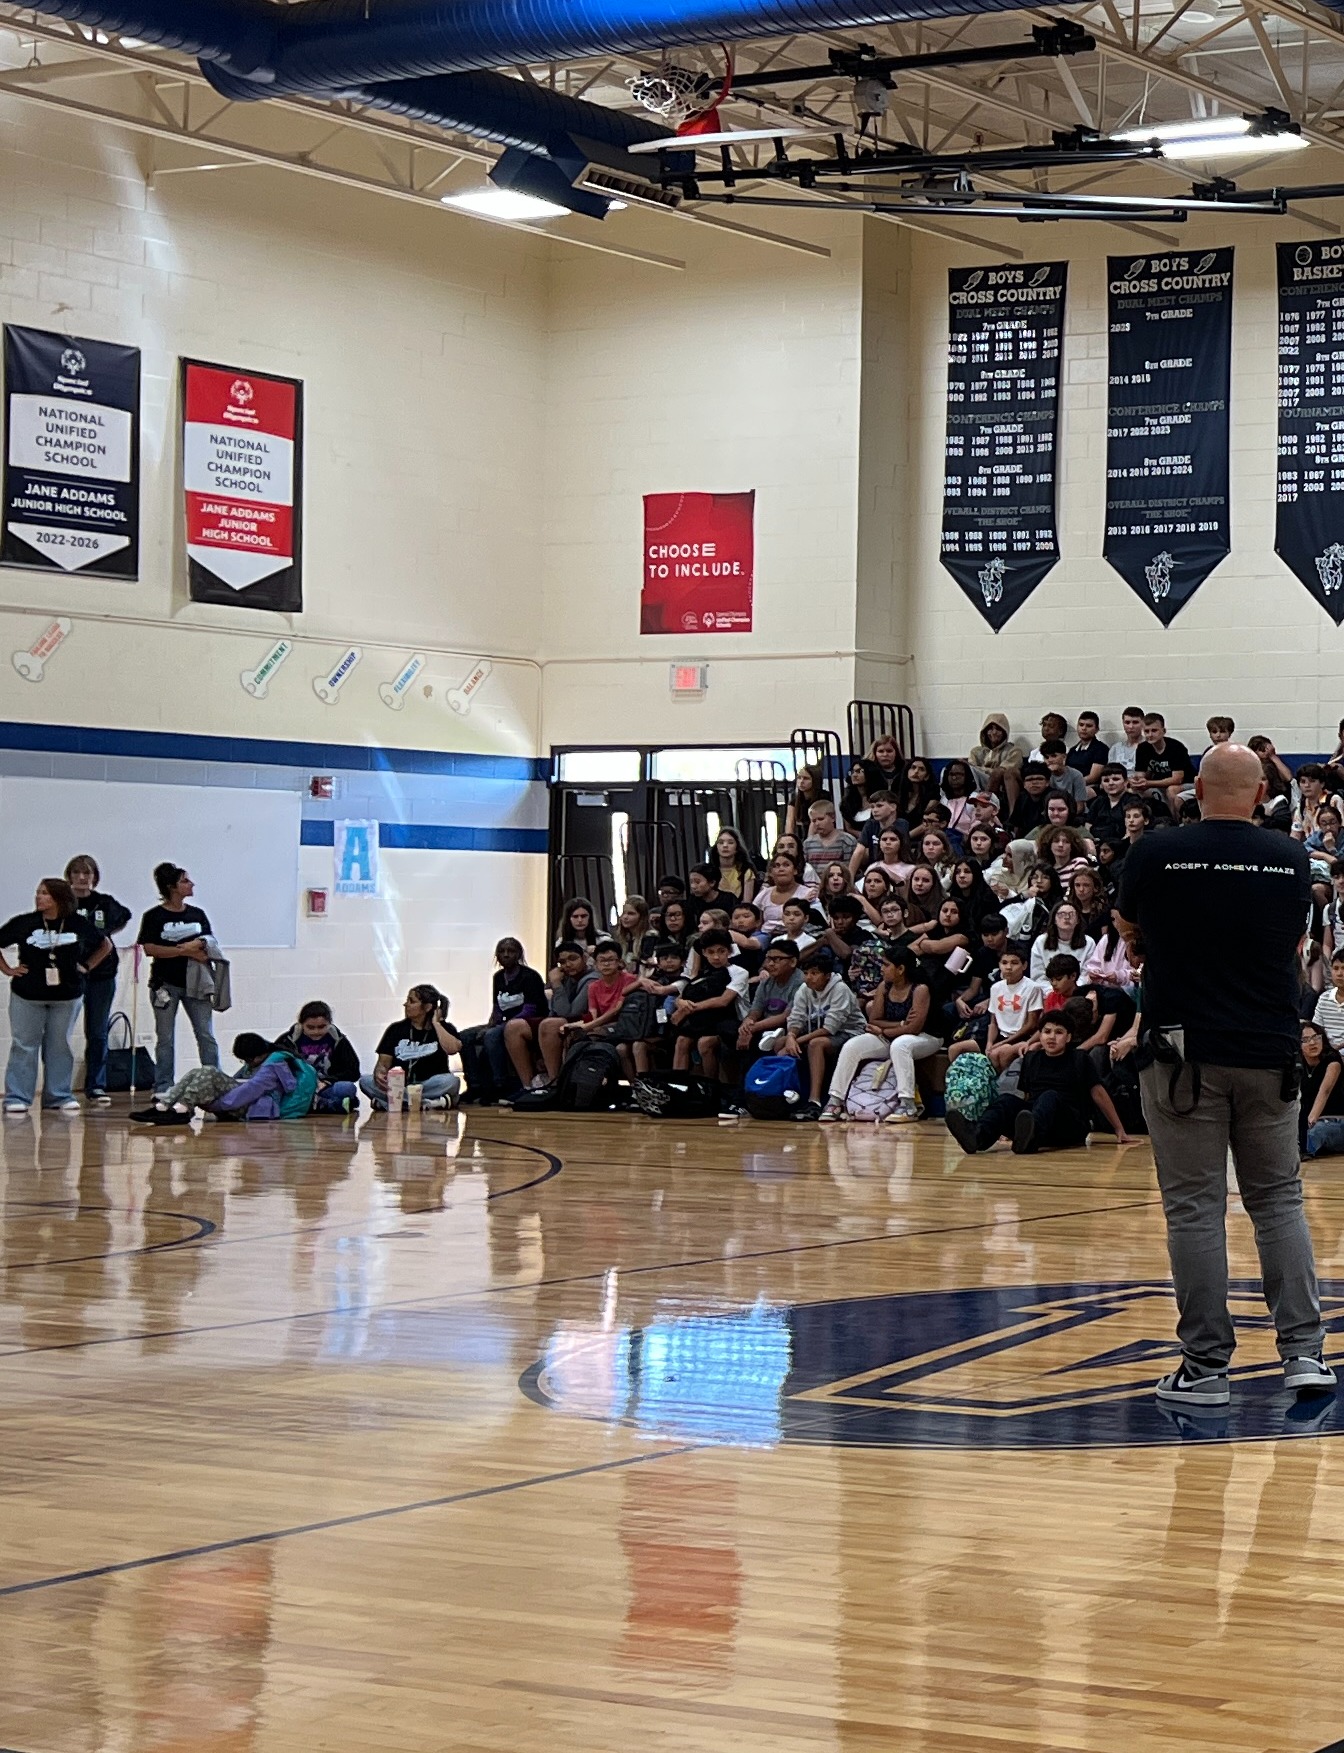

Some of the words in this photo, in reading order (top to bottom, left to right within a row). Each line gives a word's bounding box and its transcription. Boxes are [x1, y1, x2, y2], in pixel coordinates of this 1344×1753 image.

[1151, 258, 1188, 272] BOYS
[988, 271, 1023, 284] BOYS
[1110, 279, 1157, 294] CROSS
[1162, 272, 1230, 290] COUNTRY
[950, 291, 994, 304] CROSS
[998, 286, 1062, 302] COUNTRY
[39, 406, 104, 426] NATIONAL
[46, 422, 96, 439] UNIFIED
[36, 436, 106, 454] CHAMPION
[210, 435, 270, 453] NATIONAL
[45, 452, 97, 468] SCHOOL
[217, 449, 262, 465] UNIFIED
[208, 462, 271, 480] CHAMPION
[216, 477, 262, 493] SCHOOL
[25, 484, 58, 497] JANE
[61, 488, 115, 505] ADDAMS
[12, 498, 52, 511] JUNIOR
[55, 503, 81, 514] HIGH
[84, 507, 127, 521] SCHOOL
[201, 503, 228, 515] JANE
[230, 508, 275, 522] ADDAMS
[218, 518, 257, 532] JUNIOR
[36, 532, 99, 549] 2022-2026
[202, 528, 228, 540] HIGH
[231, 532, 272, 547] SCHOOL
[650, 543, 715, 558] CHOOSE
[649, 565, 668, 578] TO
[329, 651, 357, 687] OWNERSHIP
[340, 827, 373, 880] A
[1263, 866, 1295, 875] AMAZE
